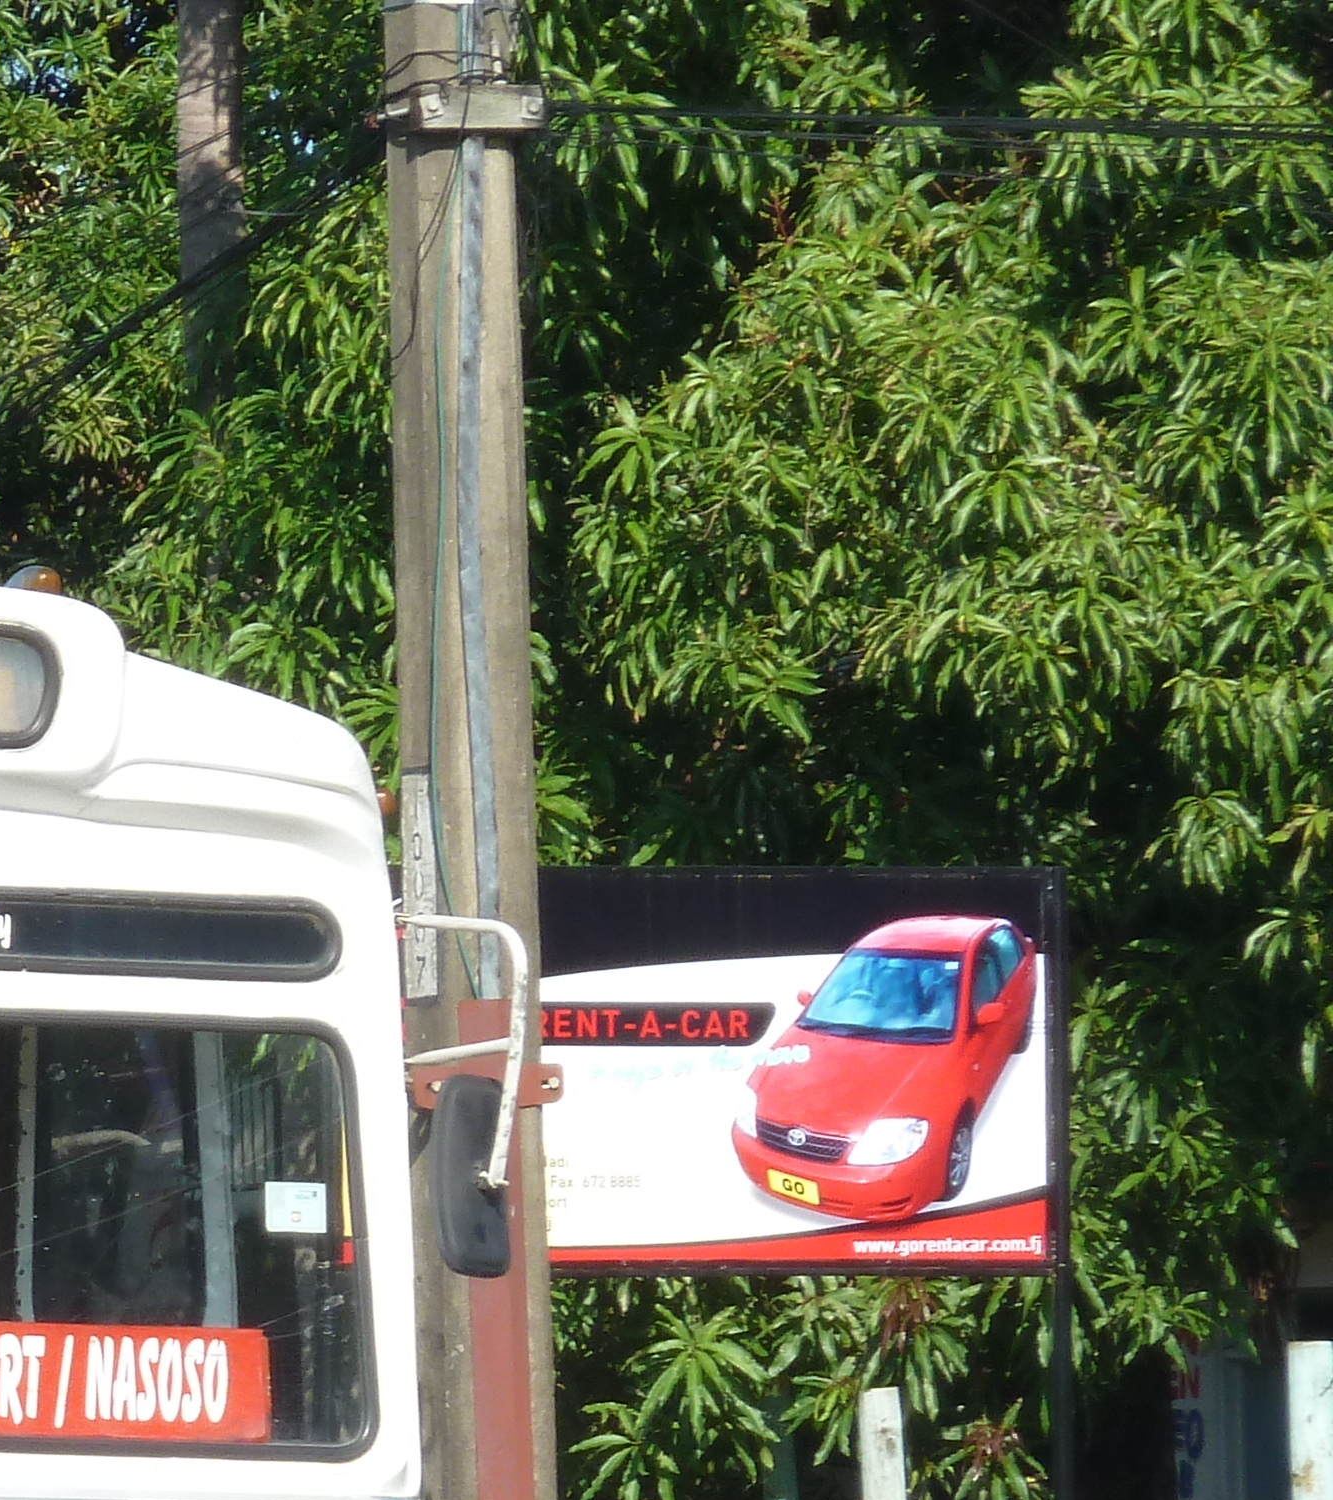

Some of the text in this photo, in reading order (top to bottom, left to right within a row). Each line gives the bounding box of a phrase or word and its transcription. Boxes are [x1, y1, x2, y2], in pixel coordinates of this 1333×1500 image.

[751, 1044, 811, 1066] move
[582, 1175, 606, 1188] 672
[773, 1178, 805, 1195] GO
[853, 1234, 1042, 1256] www.gorentacar.com.fj
[54, 1334, 74, 1428] /
[85, 1335, 229, 1424] NASOSO
